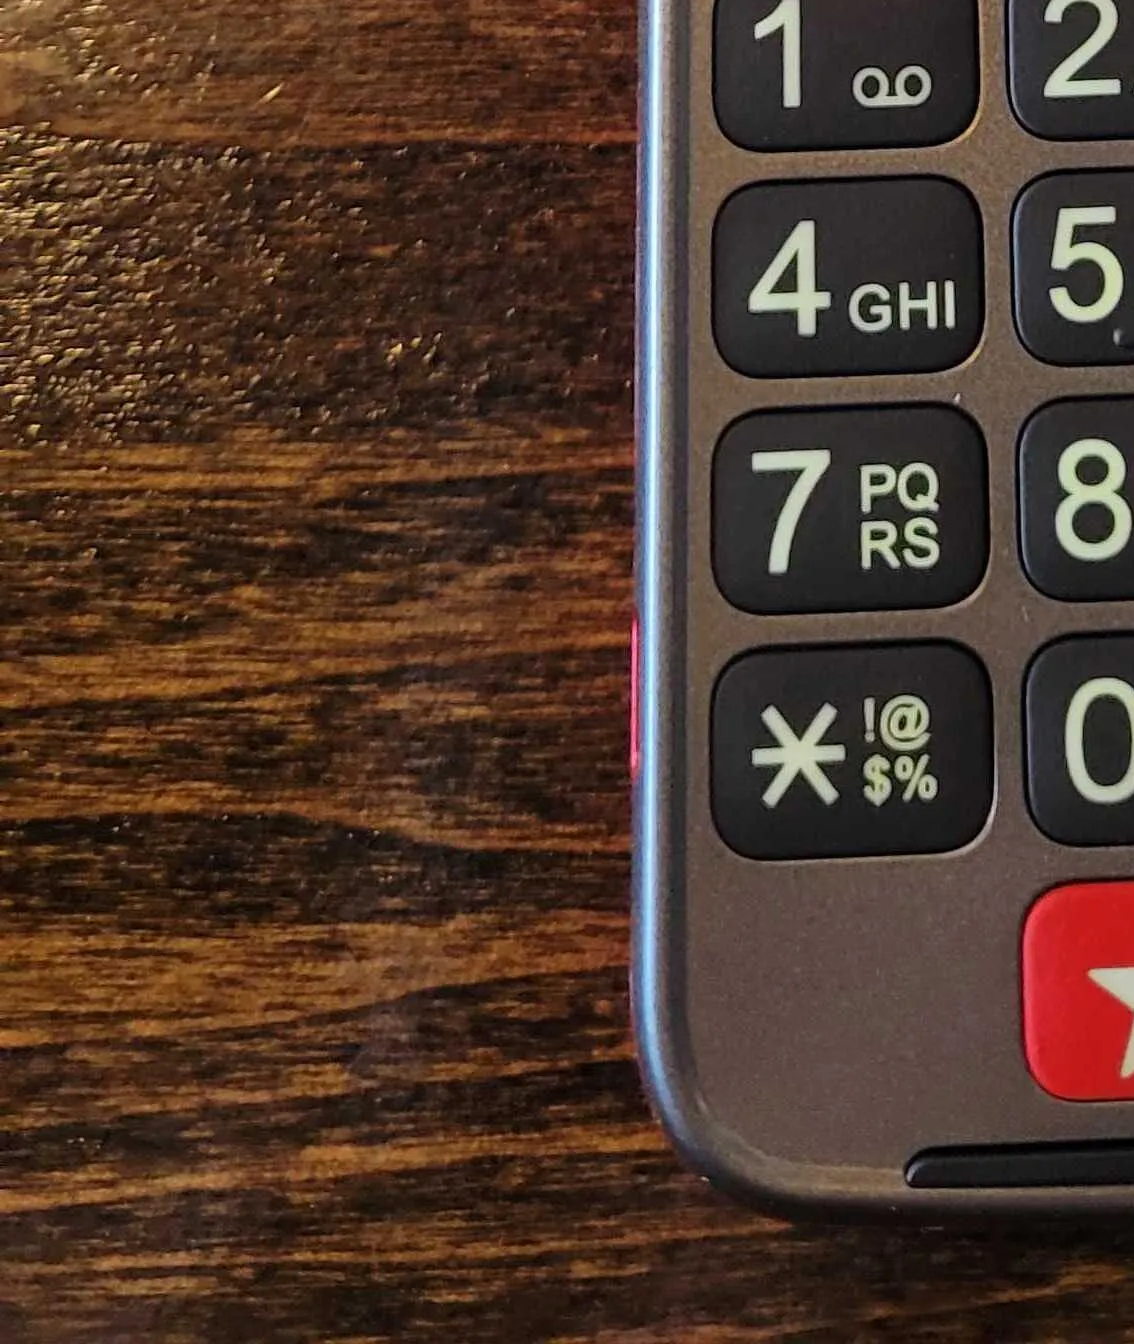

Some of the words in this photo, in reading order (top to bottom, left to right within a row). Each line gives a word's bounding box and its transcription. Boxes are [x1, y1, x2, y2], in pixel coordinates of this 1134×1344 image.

[749, 221, 830, 335] 4
[849, 281, 955, 332] GHI
[1050, 207, 1123, 322] 5
[752, 450, 830, 573] 7
[861, 463, 938, 513] PQ
[861, 517, 939, 569] RS
[1056, 439, 1131, 560] 8
